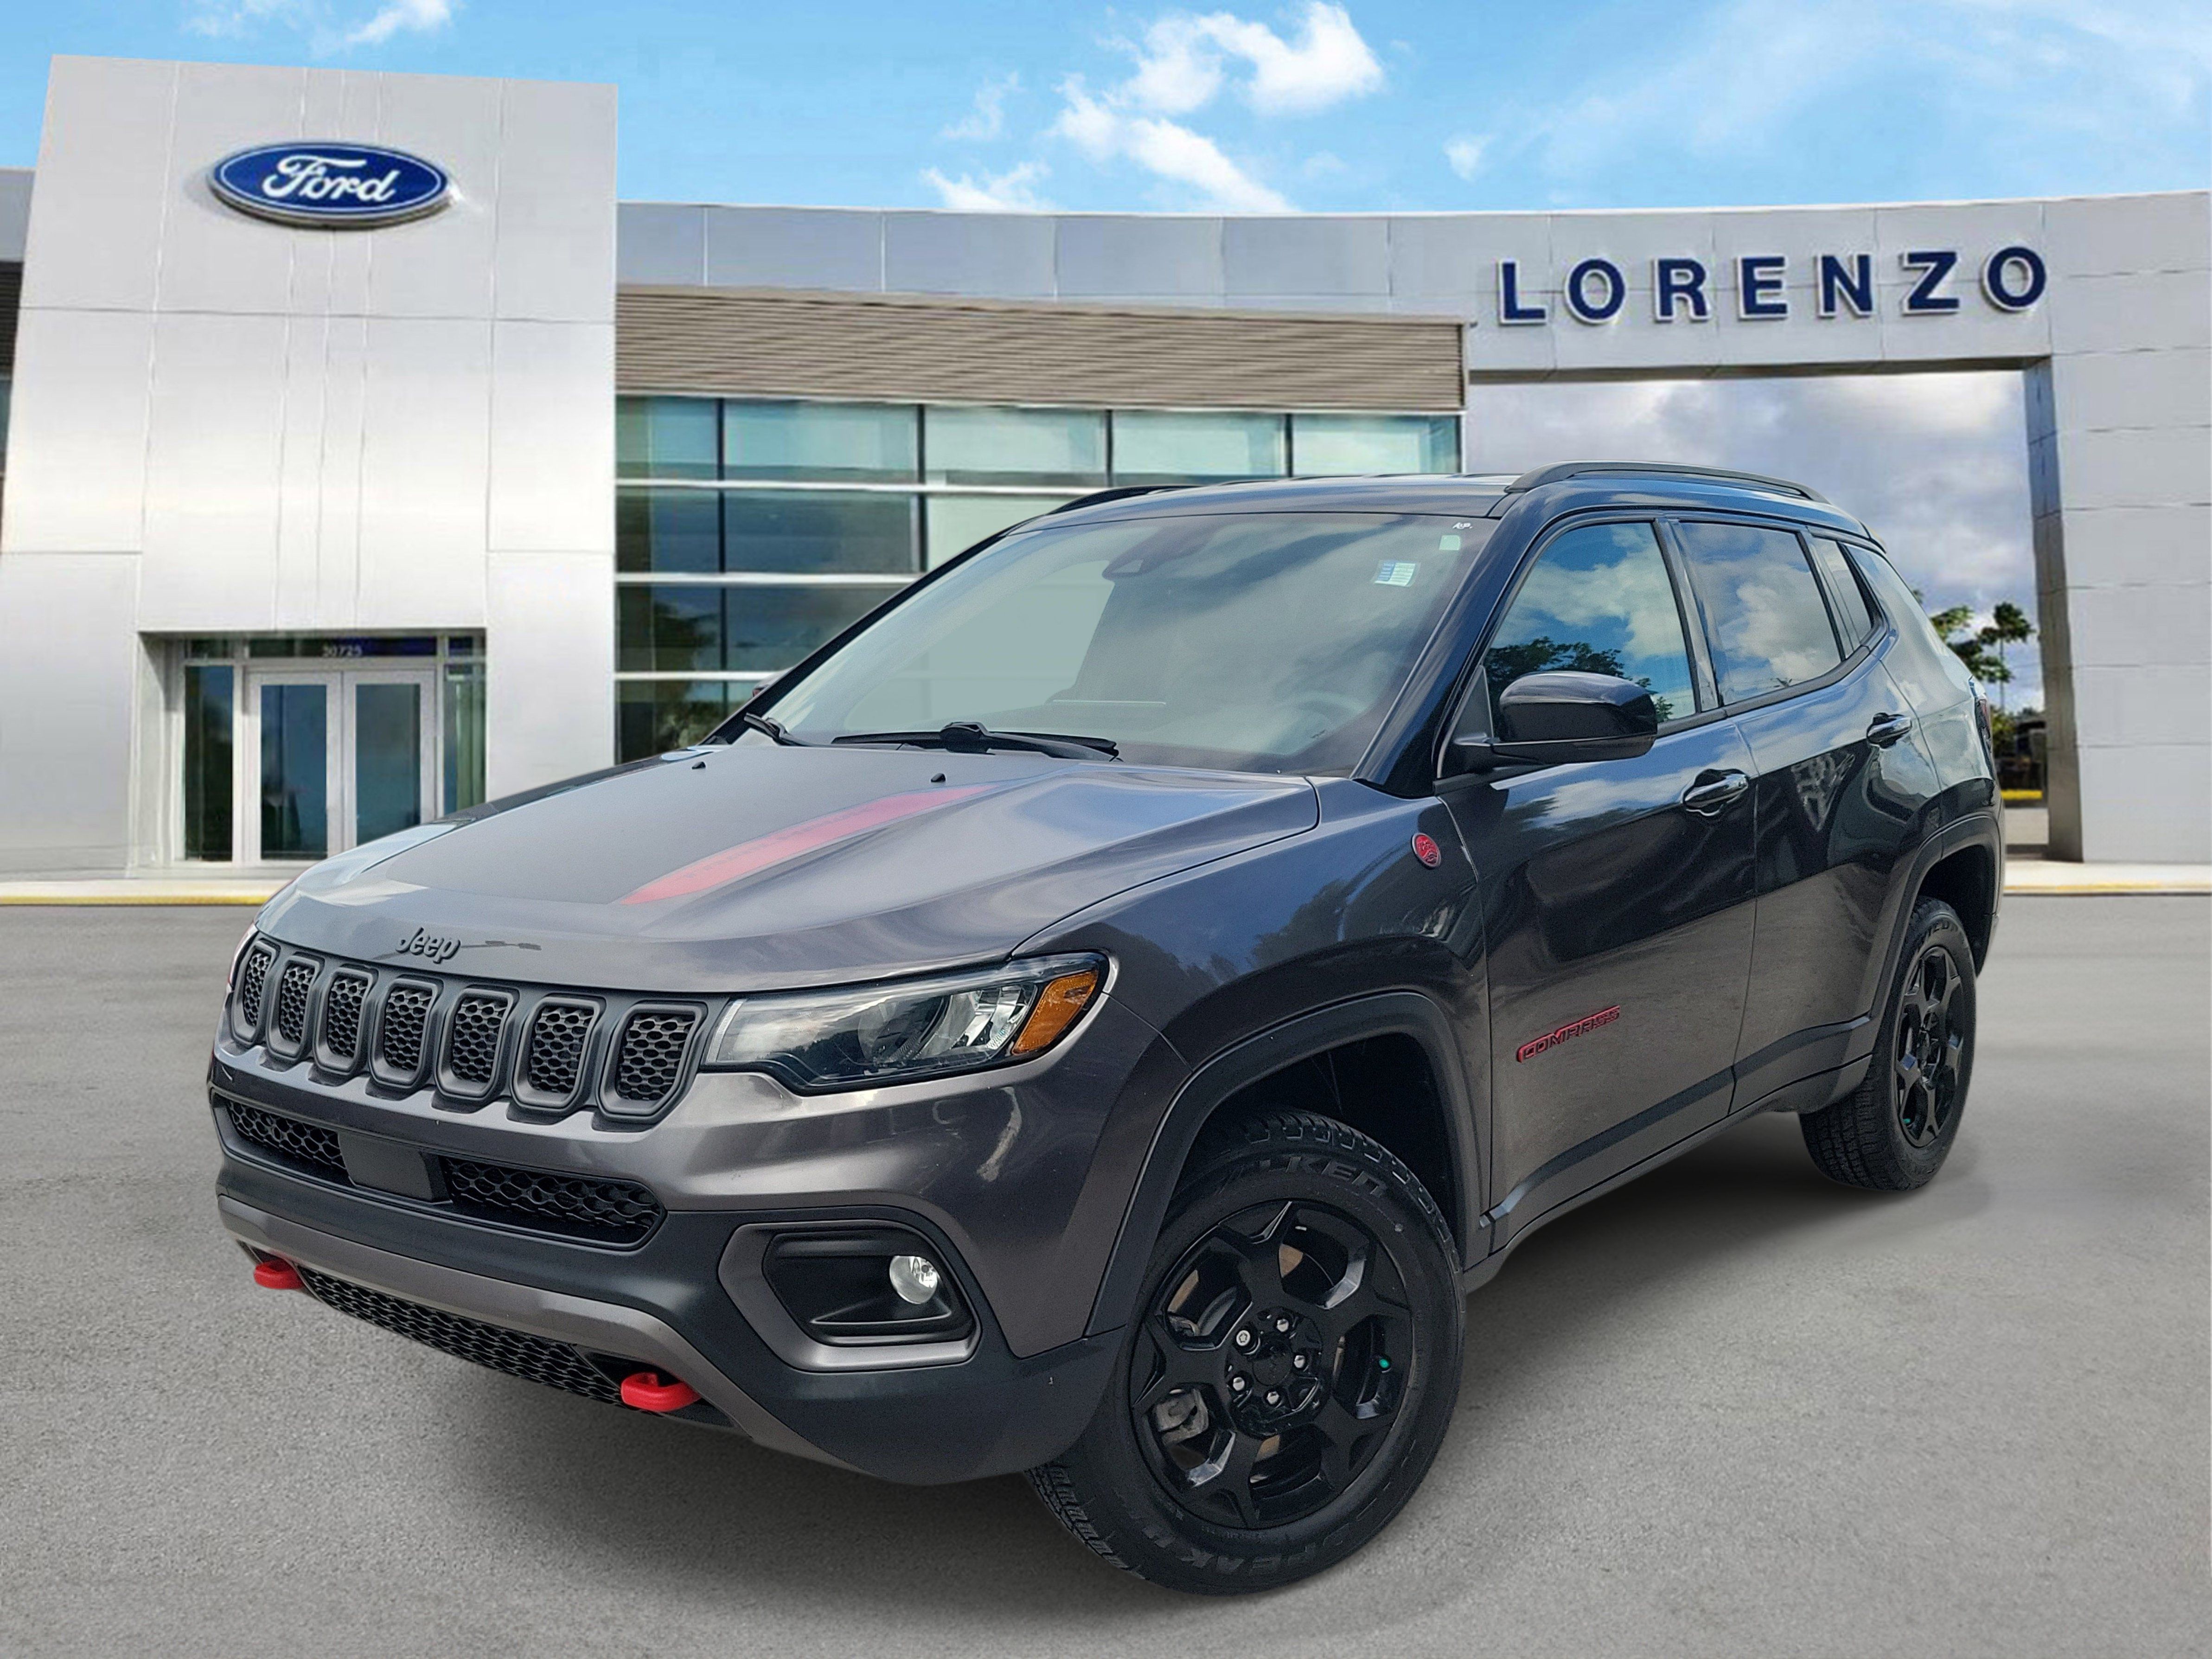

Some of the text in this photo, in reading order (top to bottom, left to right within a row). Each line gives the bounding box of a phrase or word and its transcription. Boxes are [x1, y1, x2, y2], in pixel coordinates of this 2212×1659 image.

[262, 154, 401, 201] Ford
[1496, 247, 2046, 326] LORENZO
[395, 927, 461, 964] Jeep
[1516, 1005, 1620, 1063] COMPASS
